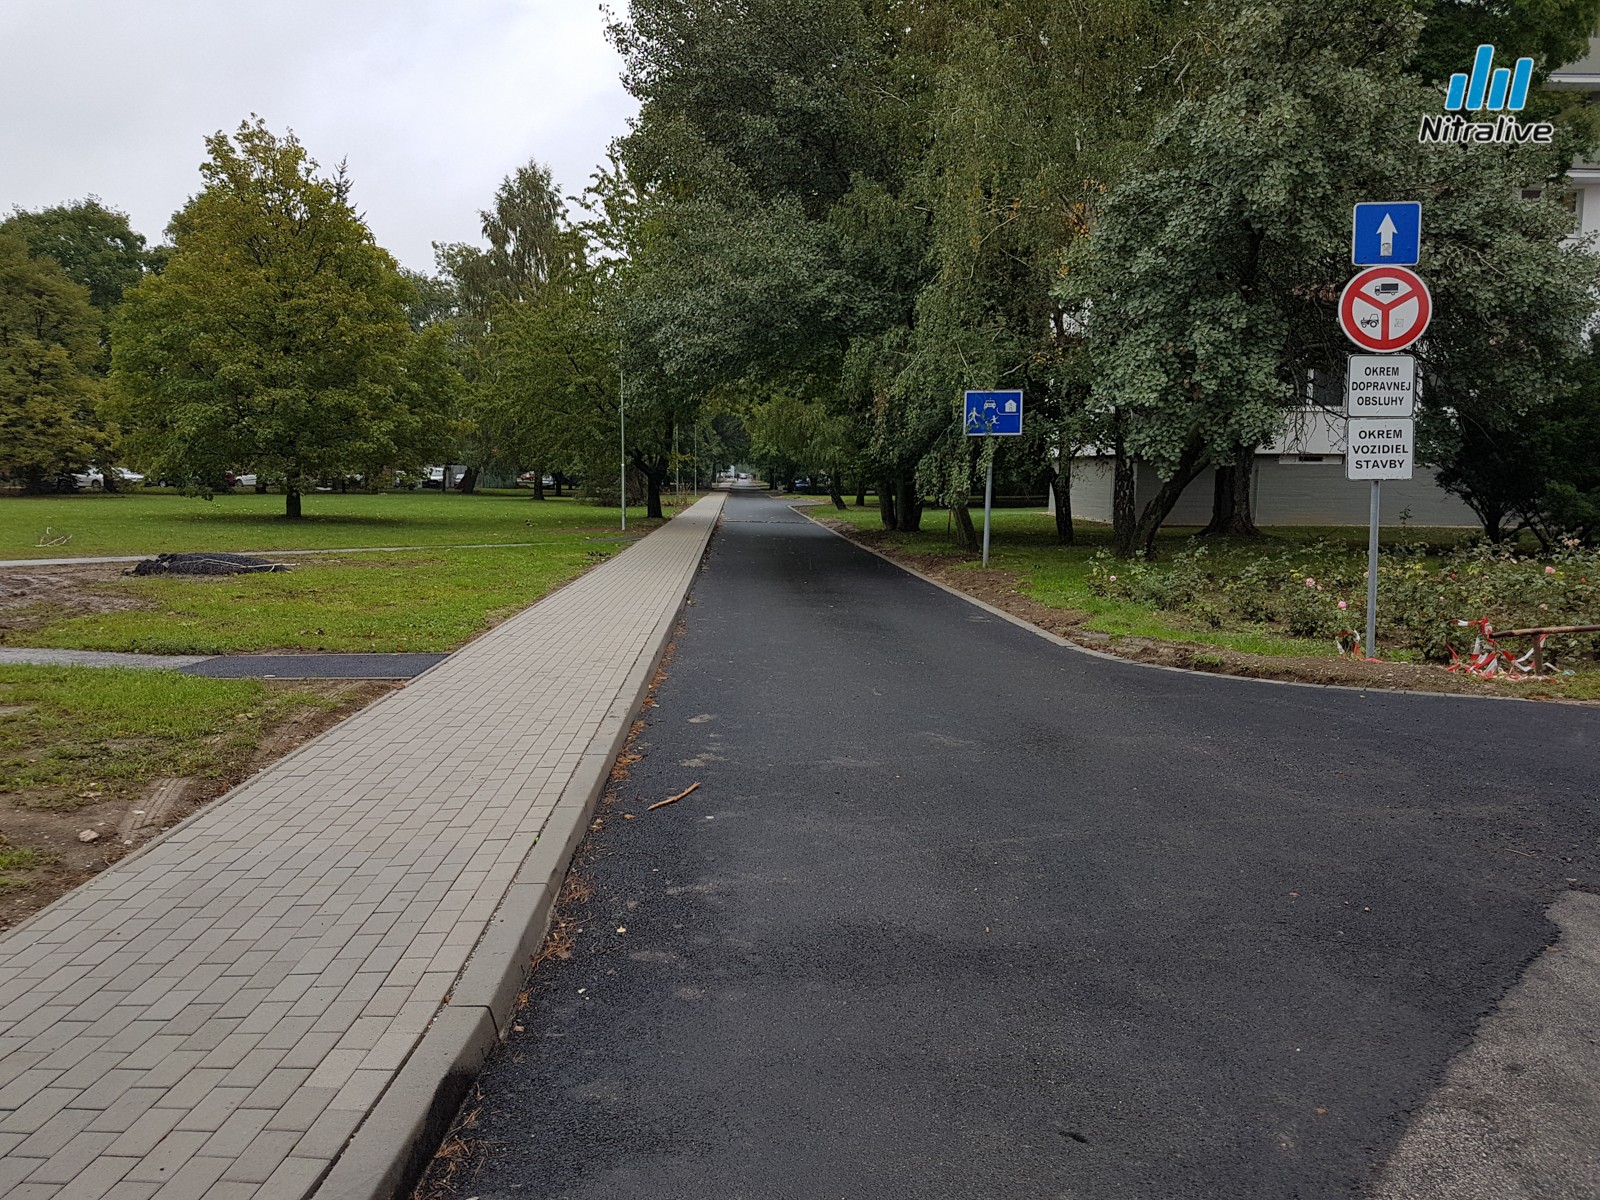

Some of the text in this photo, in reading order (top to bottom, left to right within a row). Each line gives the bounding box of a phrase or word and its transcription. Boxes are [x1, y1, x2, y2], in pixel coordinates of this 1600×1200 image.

[1364, 366, 1399, 376] OKREM
[1351, 381, 1411, 391] DOPRAVNEJ
[1357, 396, 1404, 406] OBSLUHY
[1358, 429, 1402, 439] OKREM
[1352, 444, 1408, 454] VOZIDIEL
[1355, 459, 1405, 469] STAVBY
